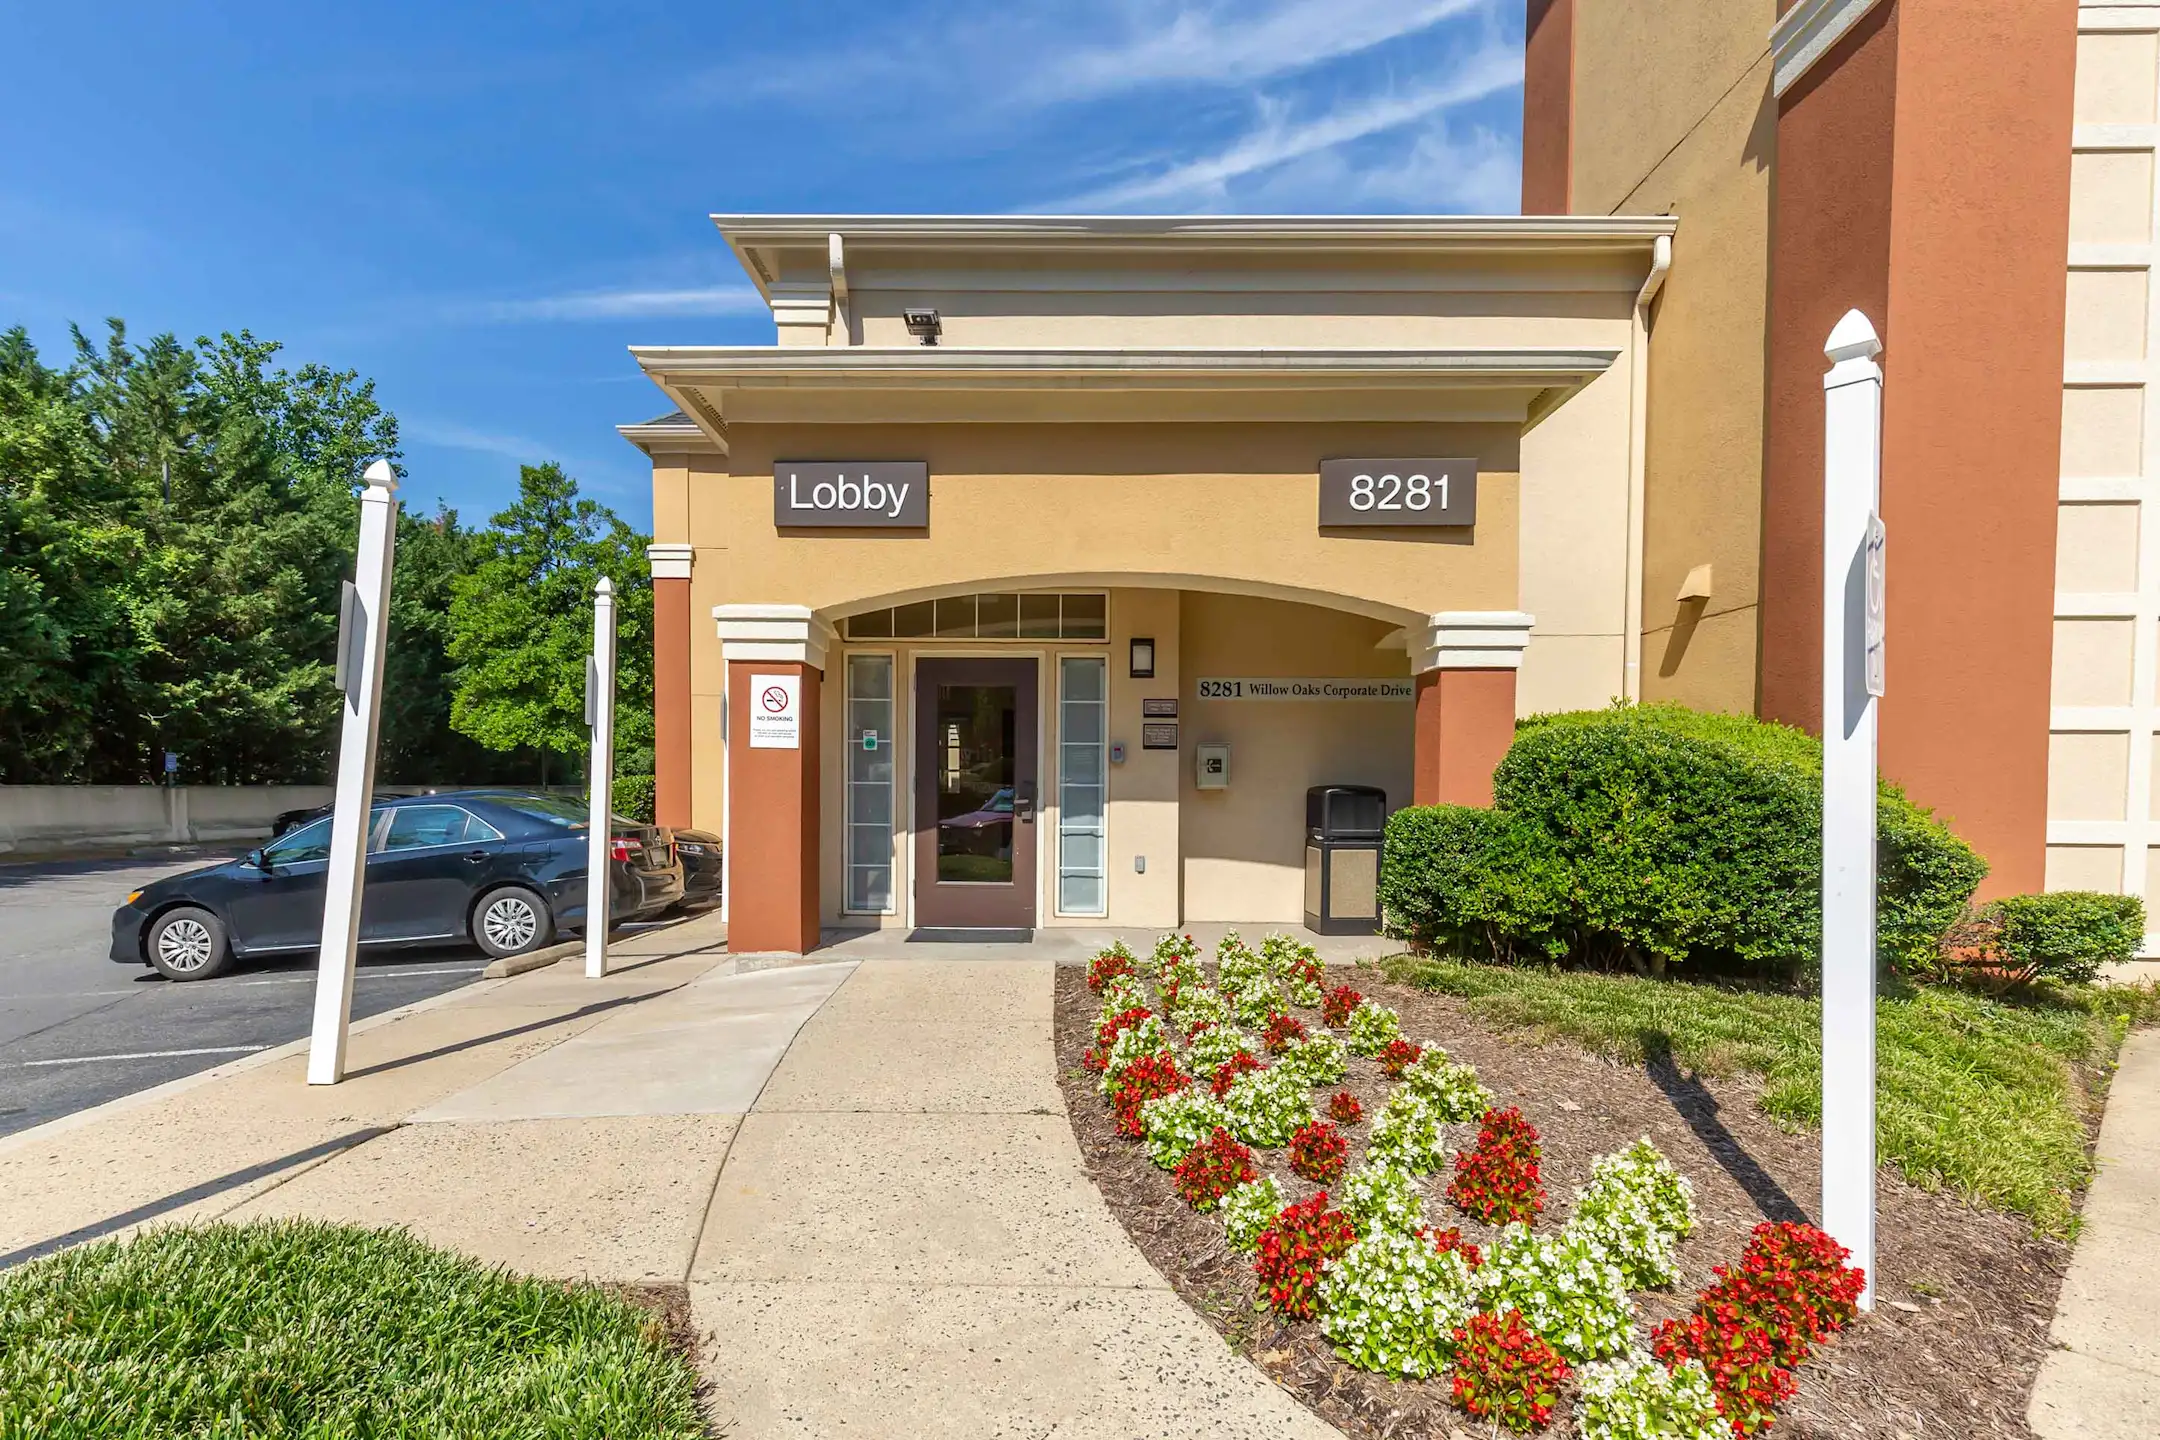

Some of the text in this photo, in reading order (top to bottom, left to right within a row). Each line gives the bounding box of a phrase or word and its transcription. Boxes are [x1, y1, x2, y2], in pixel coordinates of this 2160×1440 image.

[790, 474, 909, 518] Lobby
[1349, 474, 1449, 511] 8281
[1200, 681, 1412, 699] 8281 Willow Oaks Corporate Drive
